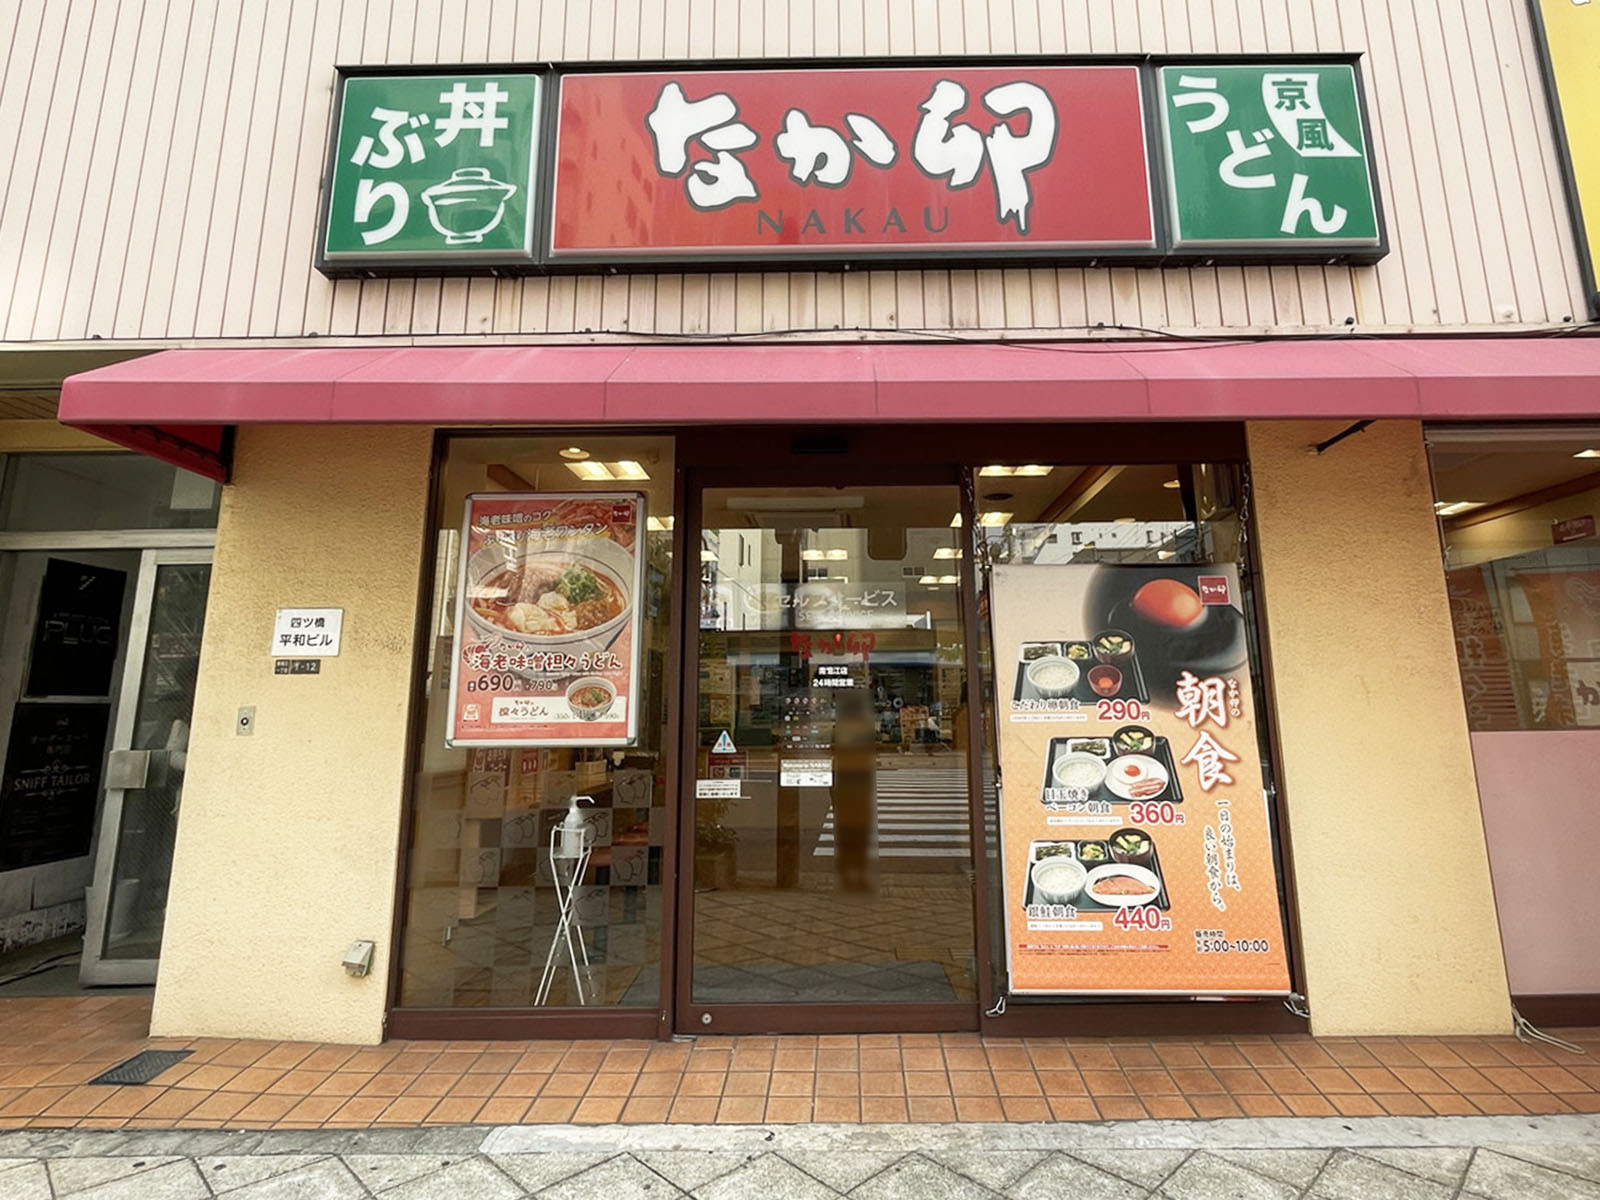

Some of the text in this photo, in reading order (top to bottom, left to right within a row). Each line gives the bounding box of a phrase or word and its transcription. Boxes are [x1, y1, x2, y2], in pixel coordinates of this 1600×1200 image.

[1272, 78, 1335, 151] 京風
[645, 78, 1058, 233] なか卯
[1172, 75, 1348, 234] うどん
[757, 207, 949, 235] NAKAU
[291, 617, 325, 628] 四ツ橋
[280, 633, 333, 647] 平和ビル
[1098, 700, 1151, 722] 290円
[1175, 672, 1239, 791] 朝食
[14, 773, 91, 792] SNIFF TAILOR
[1131, 803, 1184, 824] 360円
[1115, 908, 1171, 929] 440円
